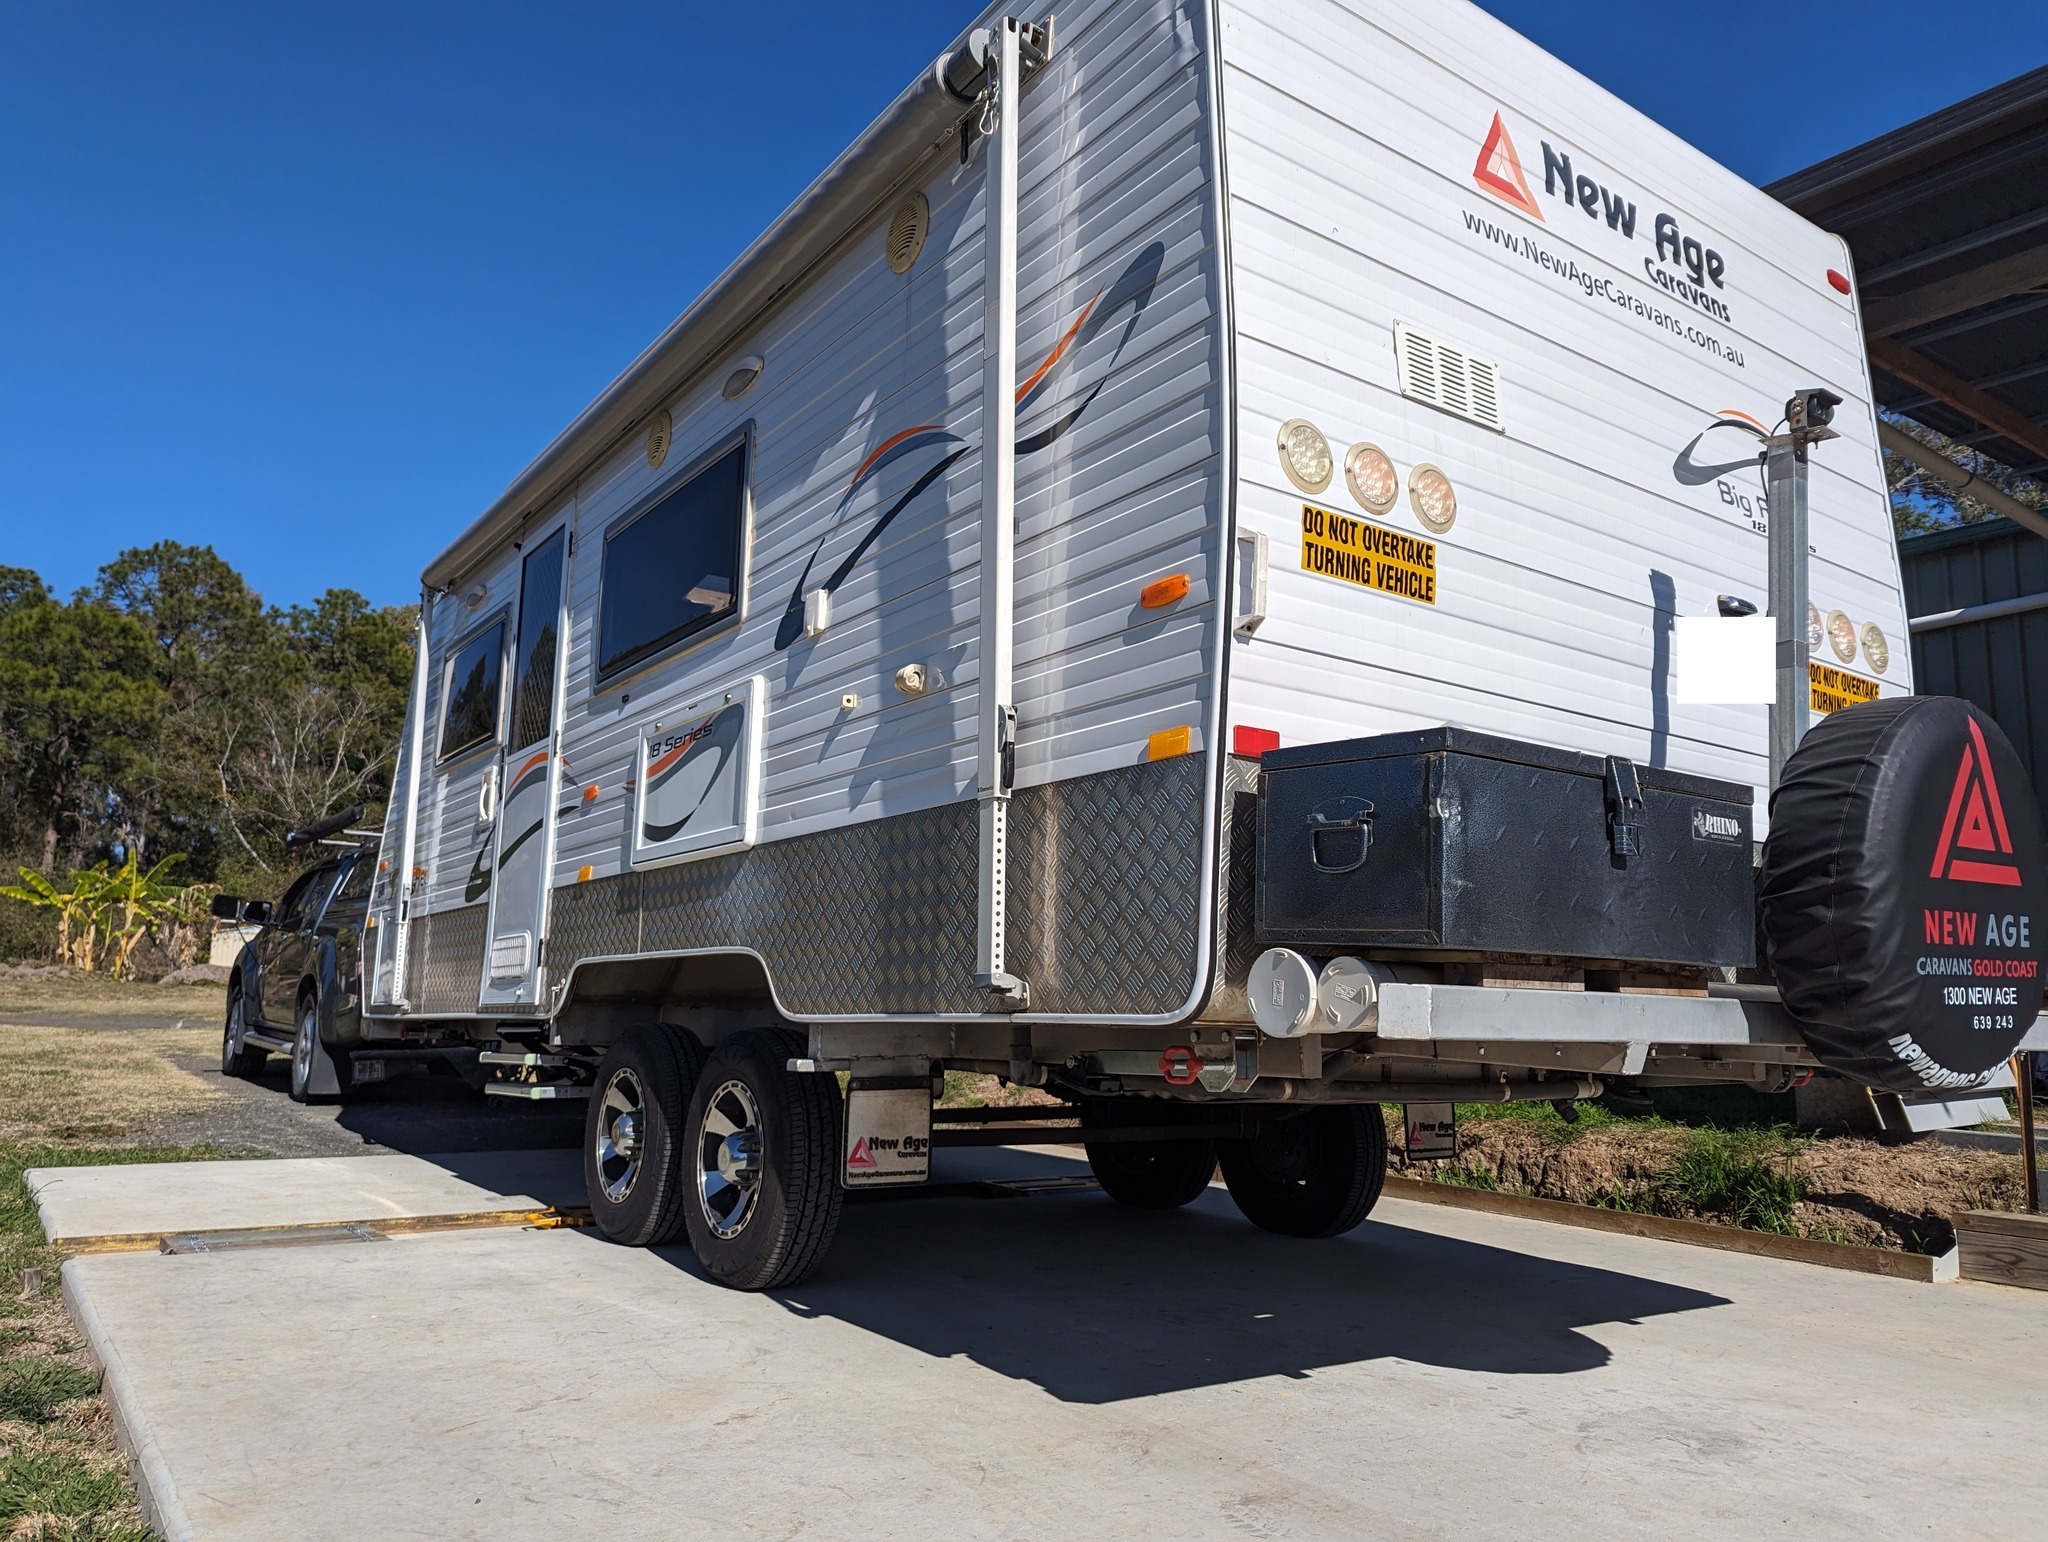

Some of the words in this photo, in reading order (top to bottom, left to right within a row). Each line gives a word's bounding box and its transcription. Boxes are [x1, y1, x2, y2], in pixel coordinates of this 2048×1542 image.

[1540, 140, 1637, 239] New
[1655, 212, 1725, 290] Age
[1462, 209, 1746, 369] www.NewAgeCaravans.com.au
[1644, 256, 1731, 323] Caravans
[1717, 479, 1753, 519] Big
[1303, 507, 1324, 538] DO
[1328, 514, 1359, 547] NOT
[1362, 528, 1434, 570] OVERTAKE
[1751, 520, 1767, 533] 18
[1305, 541, 1371, 585] TURNING
[1376, 561, 1434, 603] VEHICLE
[1810, 663, 1822, 685] DO
[1823, 667, 1840, 690] NOT
[1841, 673, 1880, 700] OVERTAKE
[664, 723, 713, 754] Series
[1705, 813, 1739, 837] RHINO
[1924, 909, 1978, 946] NEW
[1985, 913, 2031, 949] AGE
[1916, 957, 1973, 977] CARAVANS
[1973, 959, 2004, 978] GOLD
[2005, 960, 2038, 979] COAST
[1943, 987, 1966, 1006] 1300
[1968, 988, 1993, 1006] NEW
[1994, 987, 2018, 1006] AGE
[1973, 1015, 1992, 1030] 639
[1995, 1015, 2014, 1030] 243
[868, 1136, 899, 1151] New
[903, 1135, 928, 1152] Age
